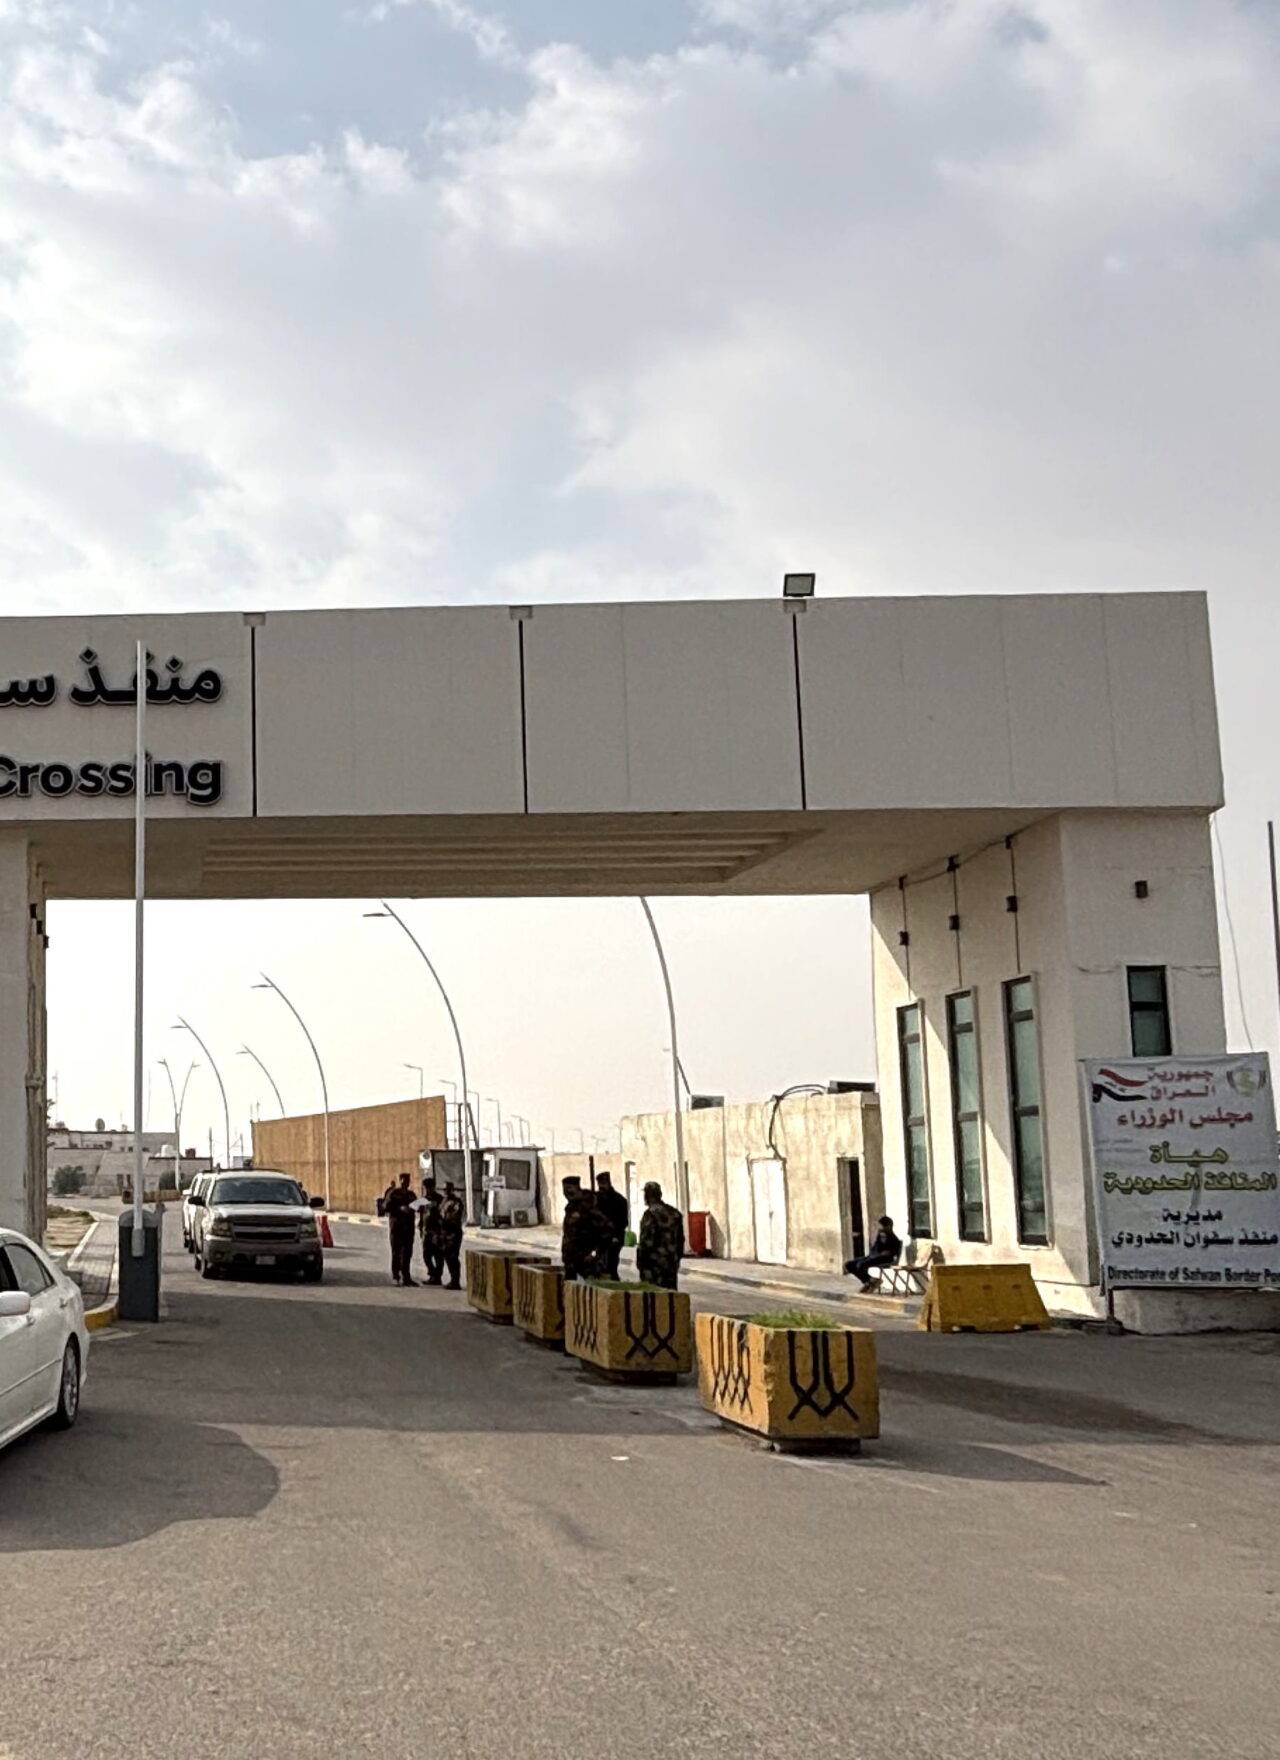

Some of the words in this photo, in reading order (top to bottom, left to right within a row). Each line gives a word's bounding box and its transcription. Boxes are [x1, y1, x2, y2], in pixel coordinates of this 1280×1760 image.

[71, 647, 223, 705] منفذ
[1147, 1066, 1214, 1083] جمهورية
[1150, 1084, 1216, 1101] العراق
[1117, 1108, 1184, 1129] الوزراء
[1189, 1106, 1254, 1128] مجلس
[1103, 1171, 1201, 1195] الحدودية
[1204, 1171, 1278, 1192] المنافذ
[1162, 1208, 1223, 1225] مديرية
[1111, 1229, 1180, 1249] الحدودي
[1183, 1230, 1234, 1249] سفوان
[1238, 1227, 1279, 1245] منفذ
